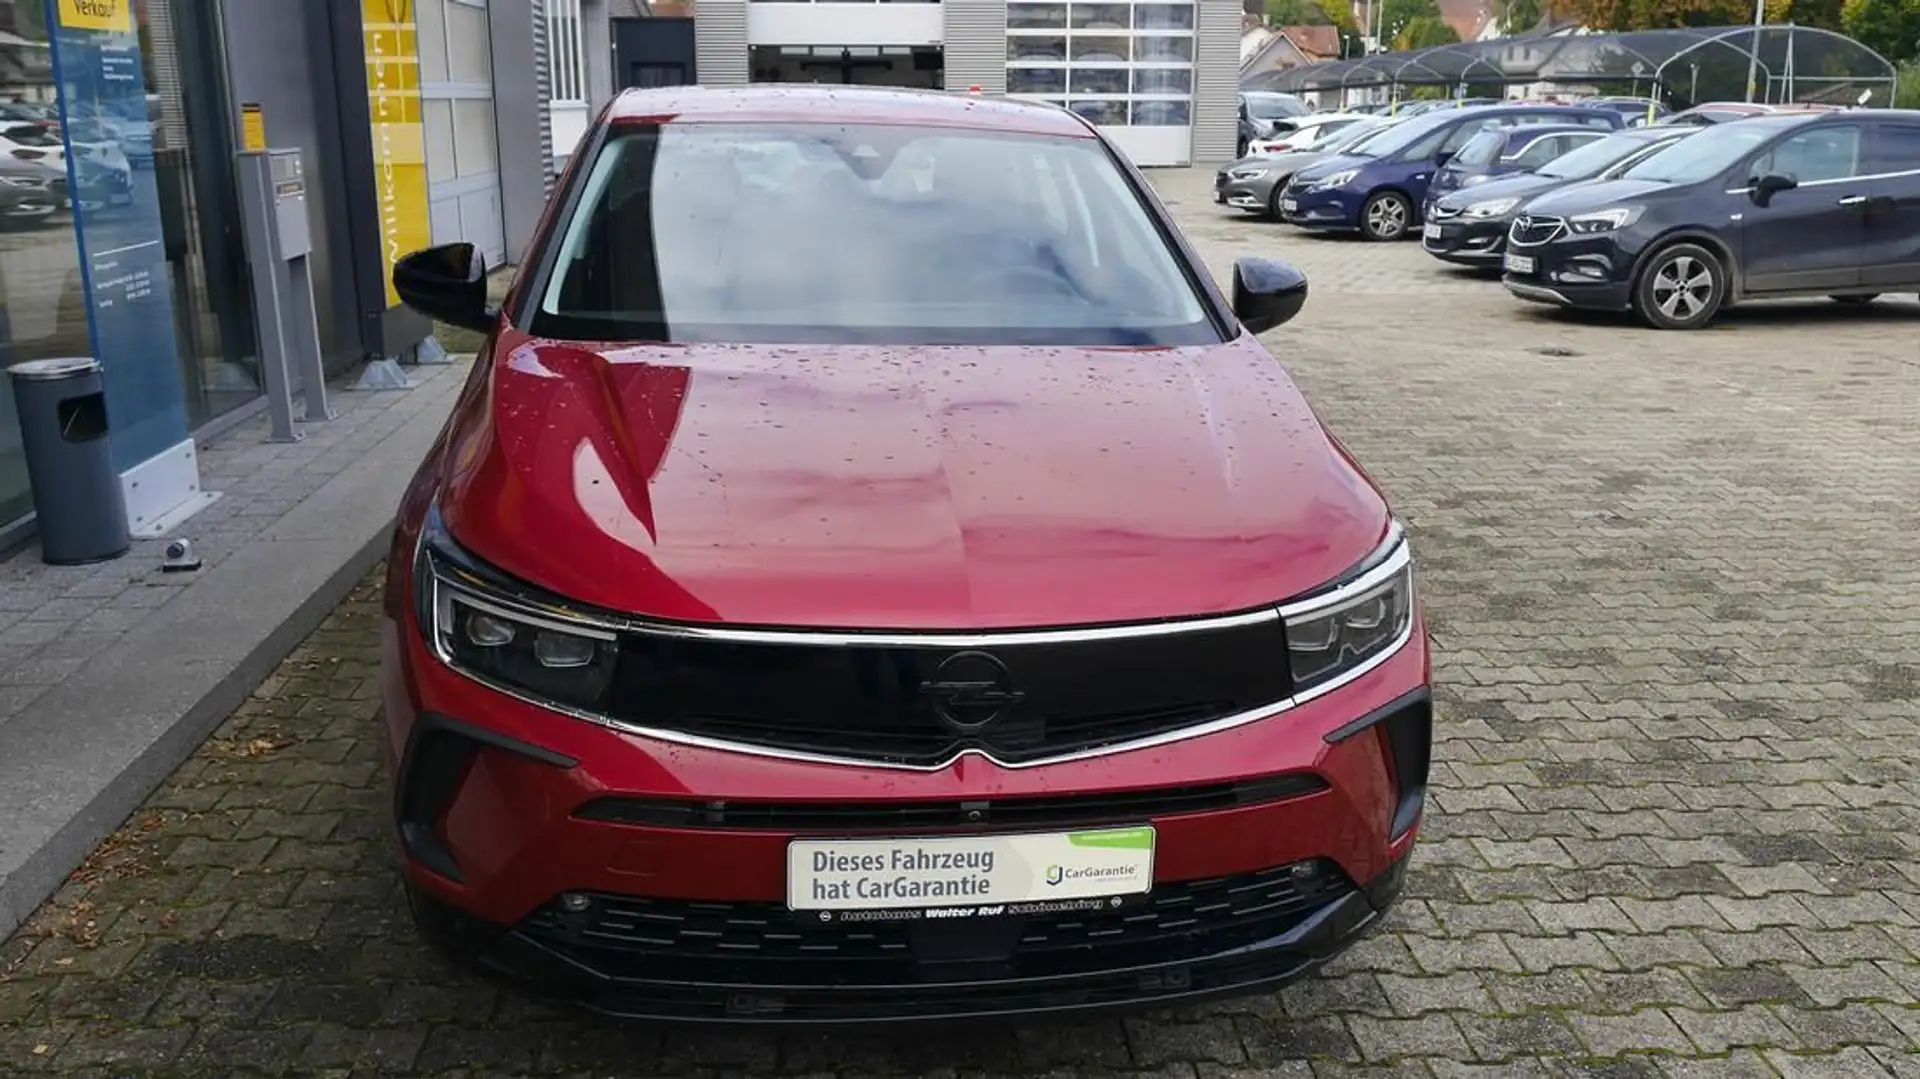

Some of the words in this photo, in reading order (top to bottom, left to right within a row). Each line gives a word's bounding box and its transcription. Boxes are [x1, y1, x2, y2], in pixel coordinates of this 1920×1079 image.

[813, 850, 884, 872] Dieses
[891, 848, 994, 873] Fahrzeug
[1065, 864, 1135, 878] CarGarantie
[813, 878, 850, 900] hat
[856, 874, 990, 899] CarGarantie
[926, 908, 975, 918] Walter
[978, 905, 1004, 916] Ruf
